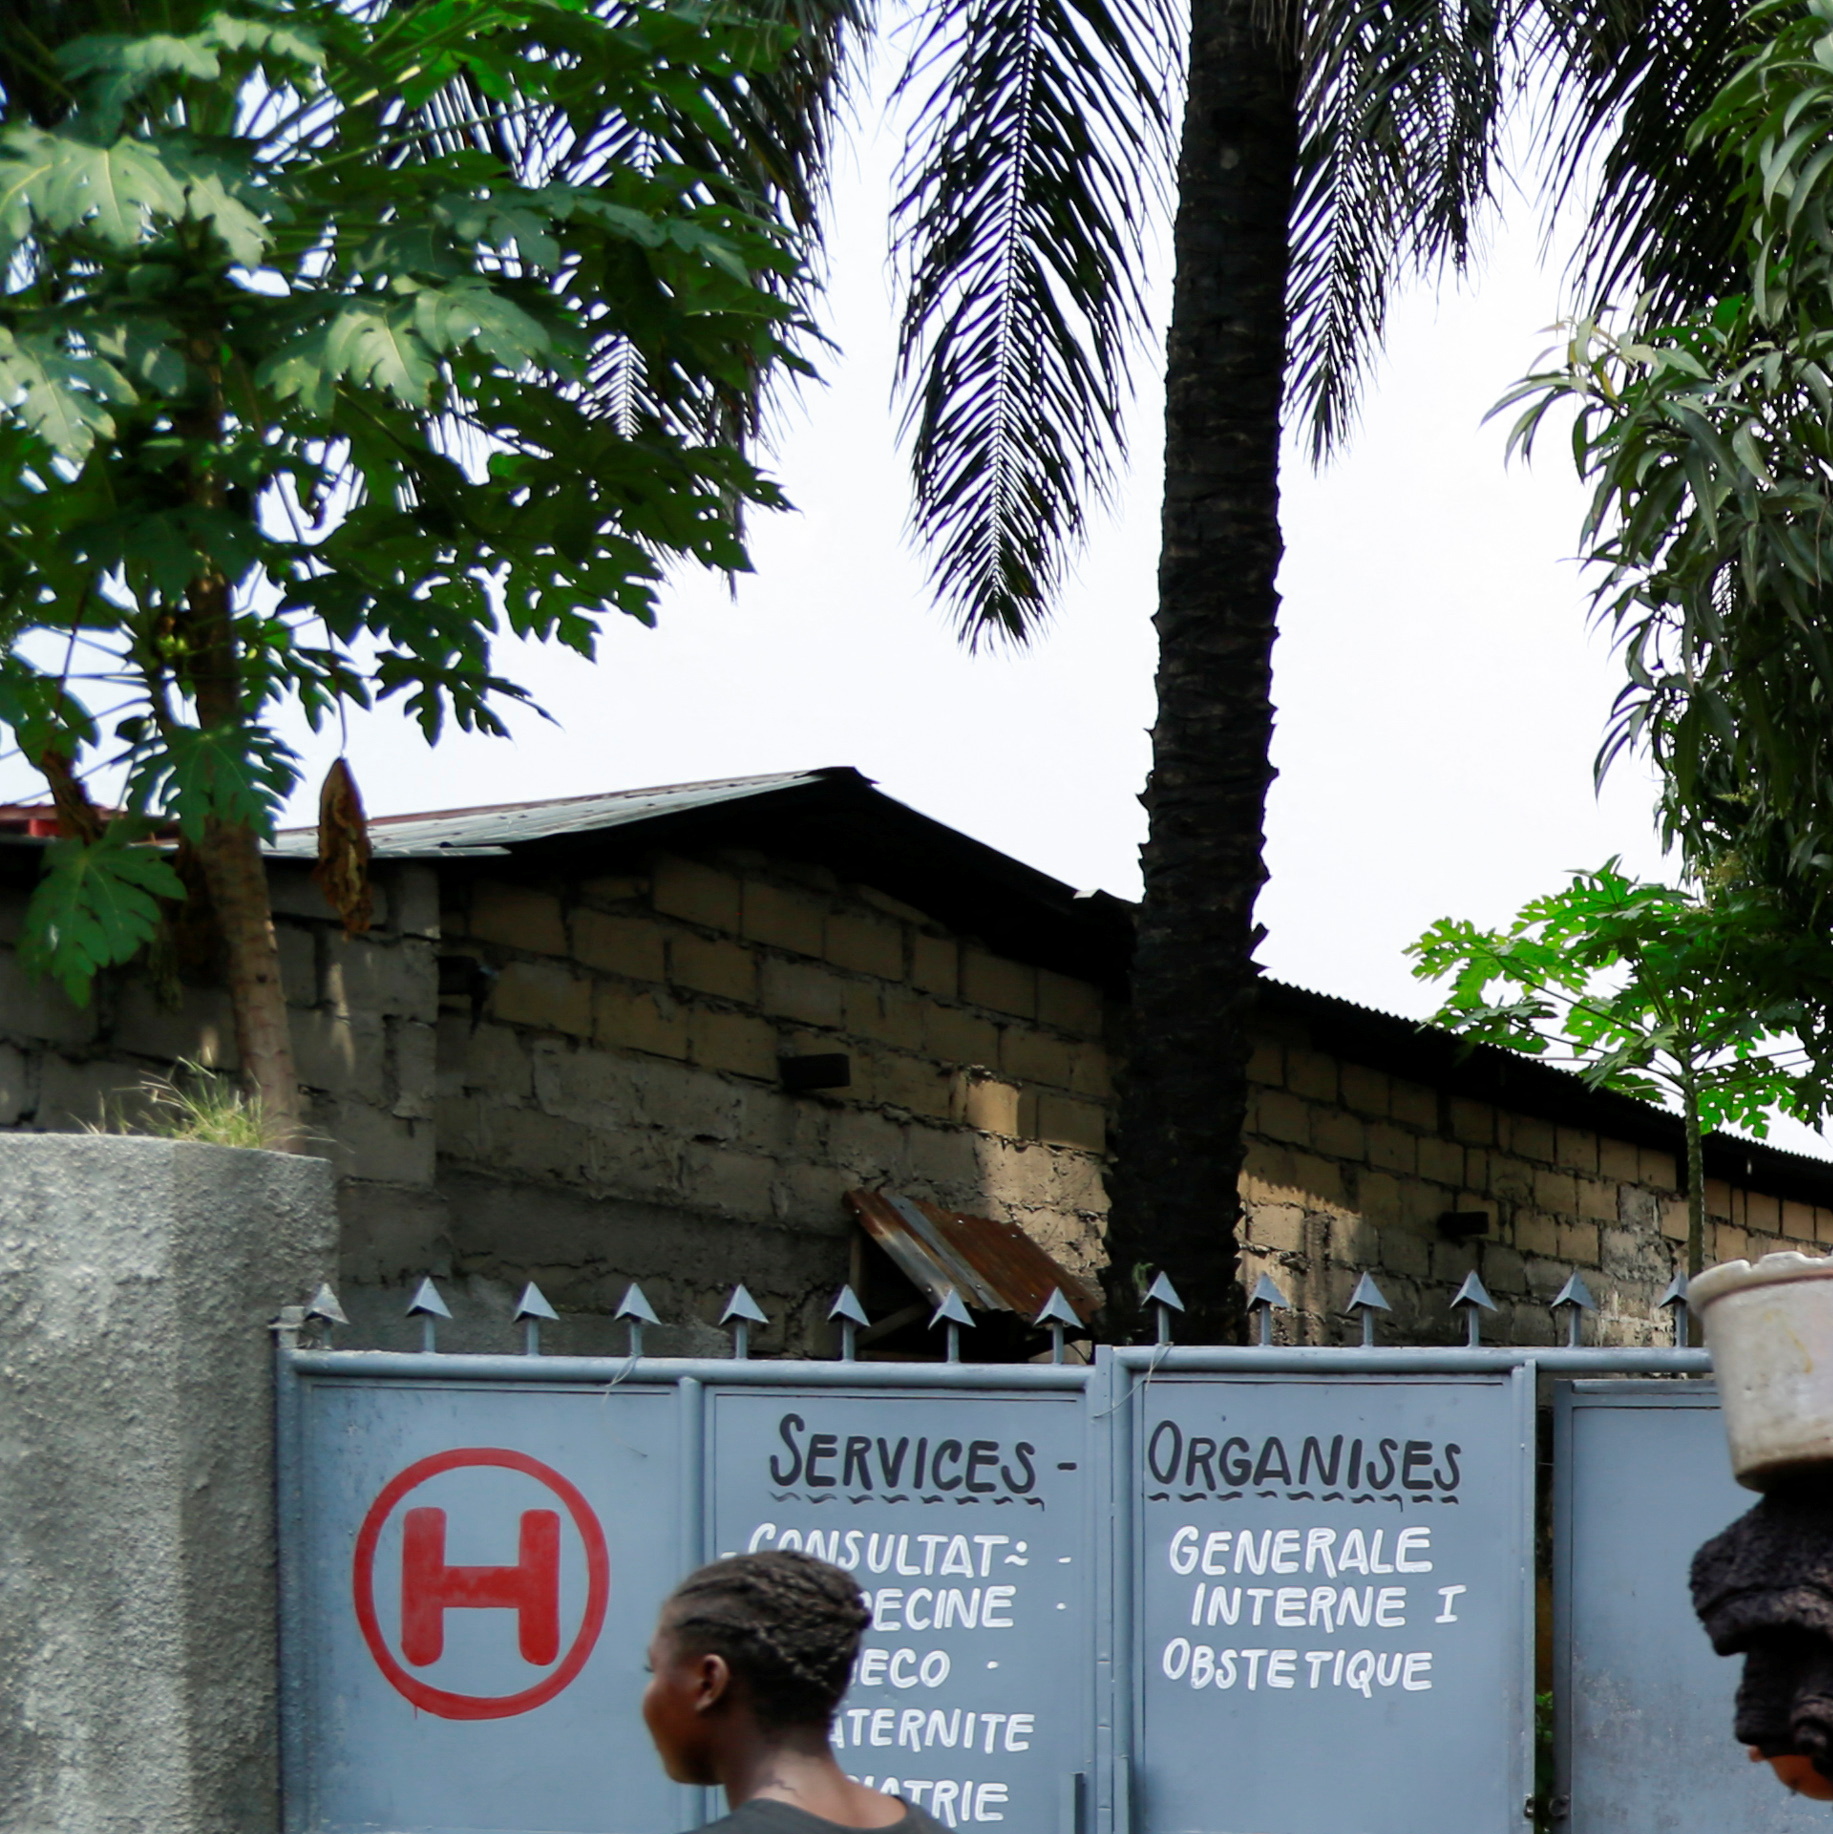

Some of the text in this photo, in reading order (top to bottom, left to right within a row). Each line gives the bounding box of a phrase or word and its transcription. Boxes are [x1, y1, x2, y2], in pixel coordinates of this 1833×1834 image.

[769, 1413, 1462, 1494] SERVICES ORGANISES
[1169, 1526, 1433, 1579] GENERALE
[401, 1507, 560, 1667] H
[862, 1585, 1017, 1632] ECINE
[1191, 1583, 1406, 1634] INTERNE
[854, 1638, 1433, 1699] ECO OBSTETIQUE
